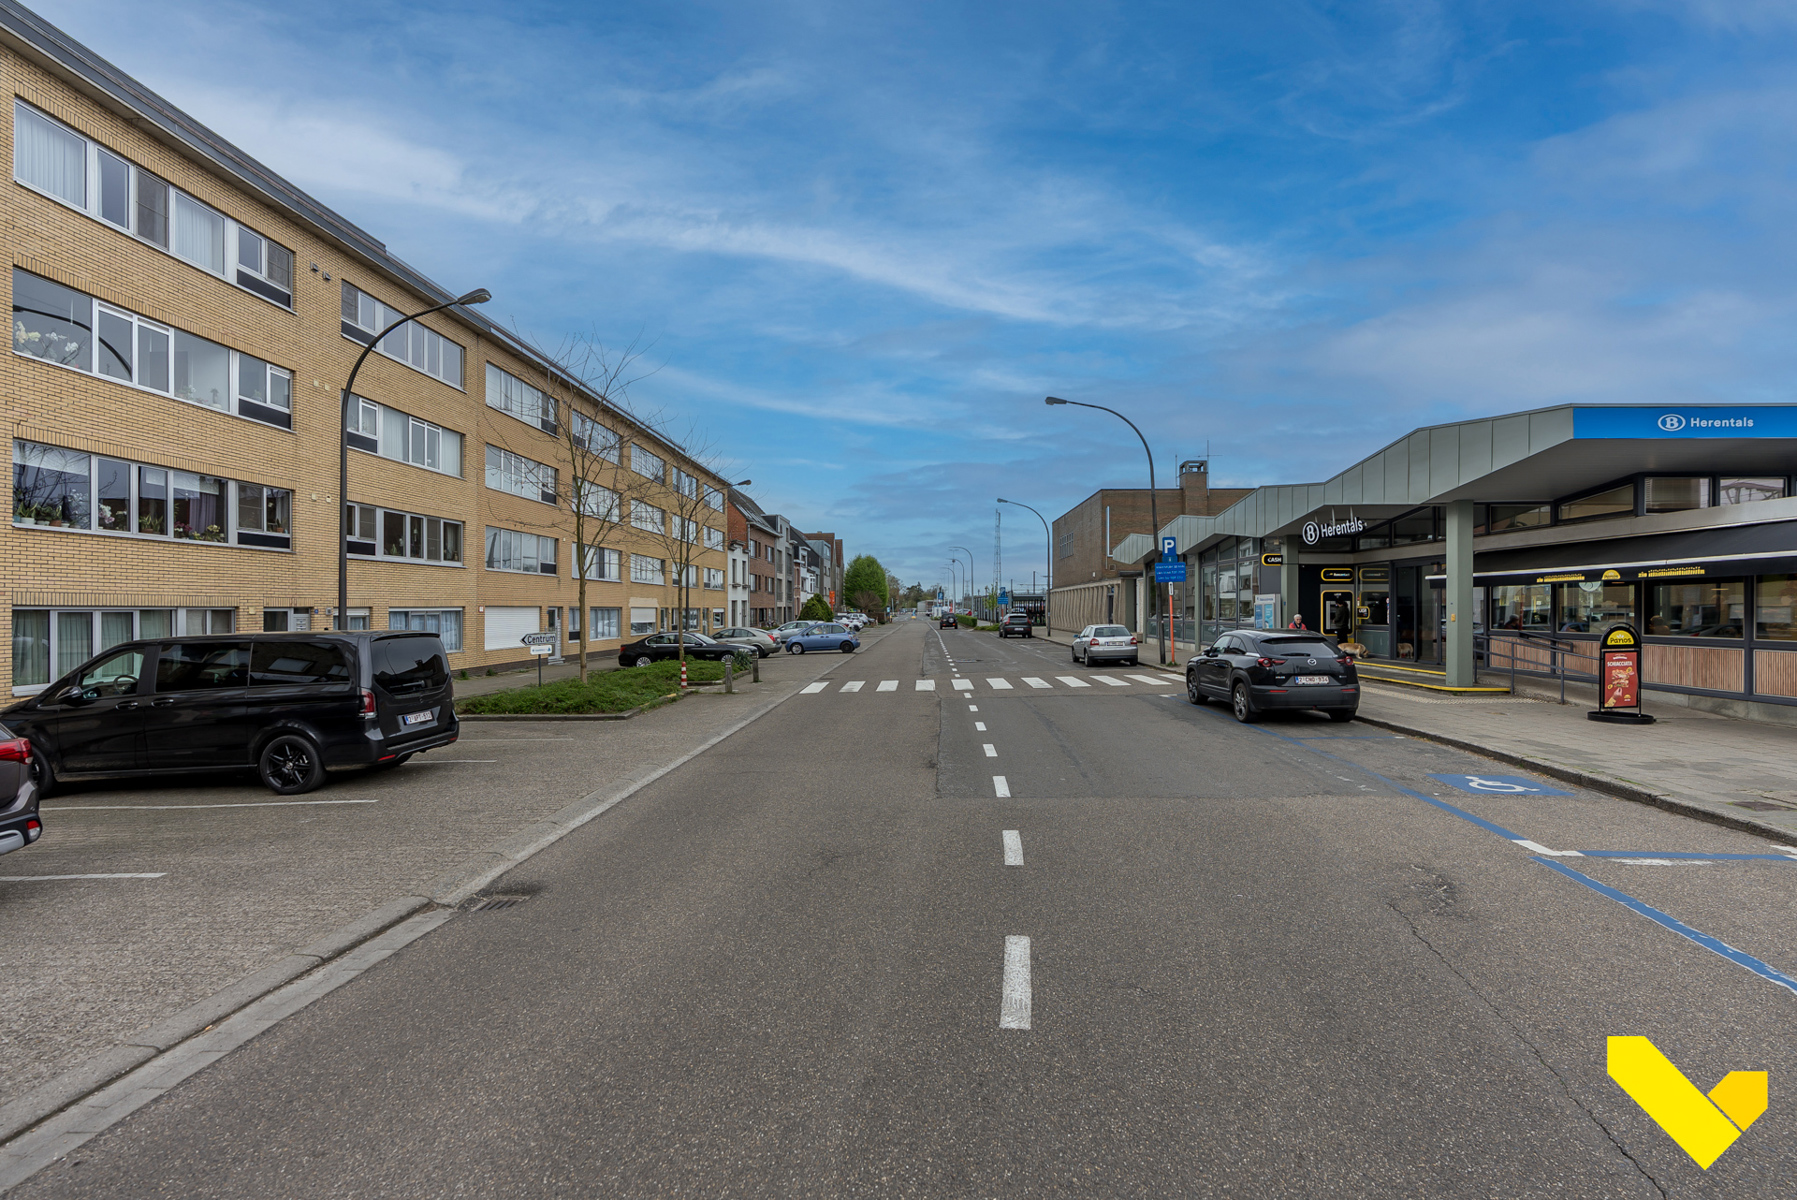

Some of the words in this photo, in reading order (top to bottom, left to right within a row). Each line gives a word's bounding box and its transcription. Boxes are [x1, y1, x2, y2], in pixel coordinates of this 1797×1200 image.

[1690, 417, 1754, 427] Herentals
[1320, 517, 1363, 538] Herentals
[1164, 540, 1175, 554] P
[527, 635, 556, 644] Centrum
